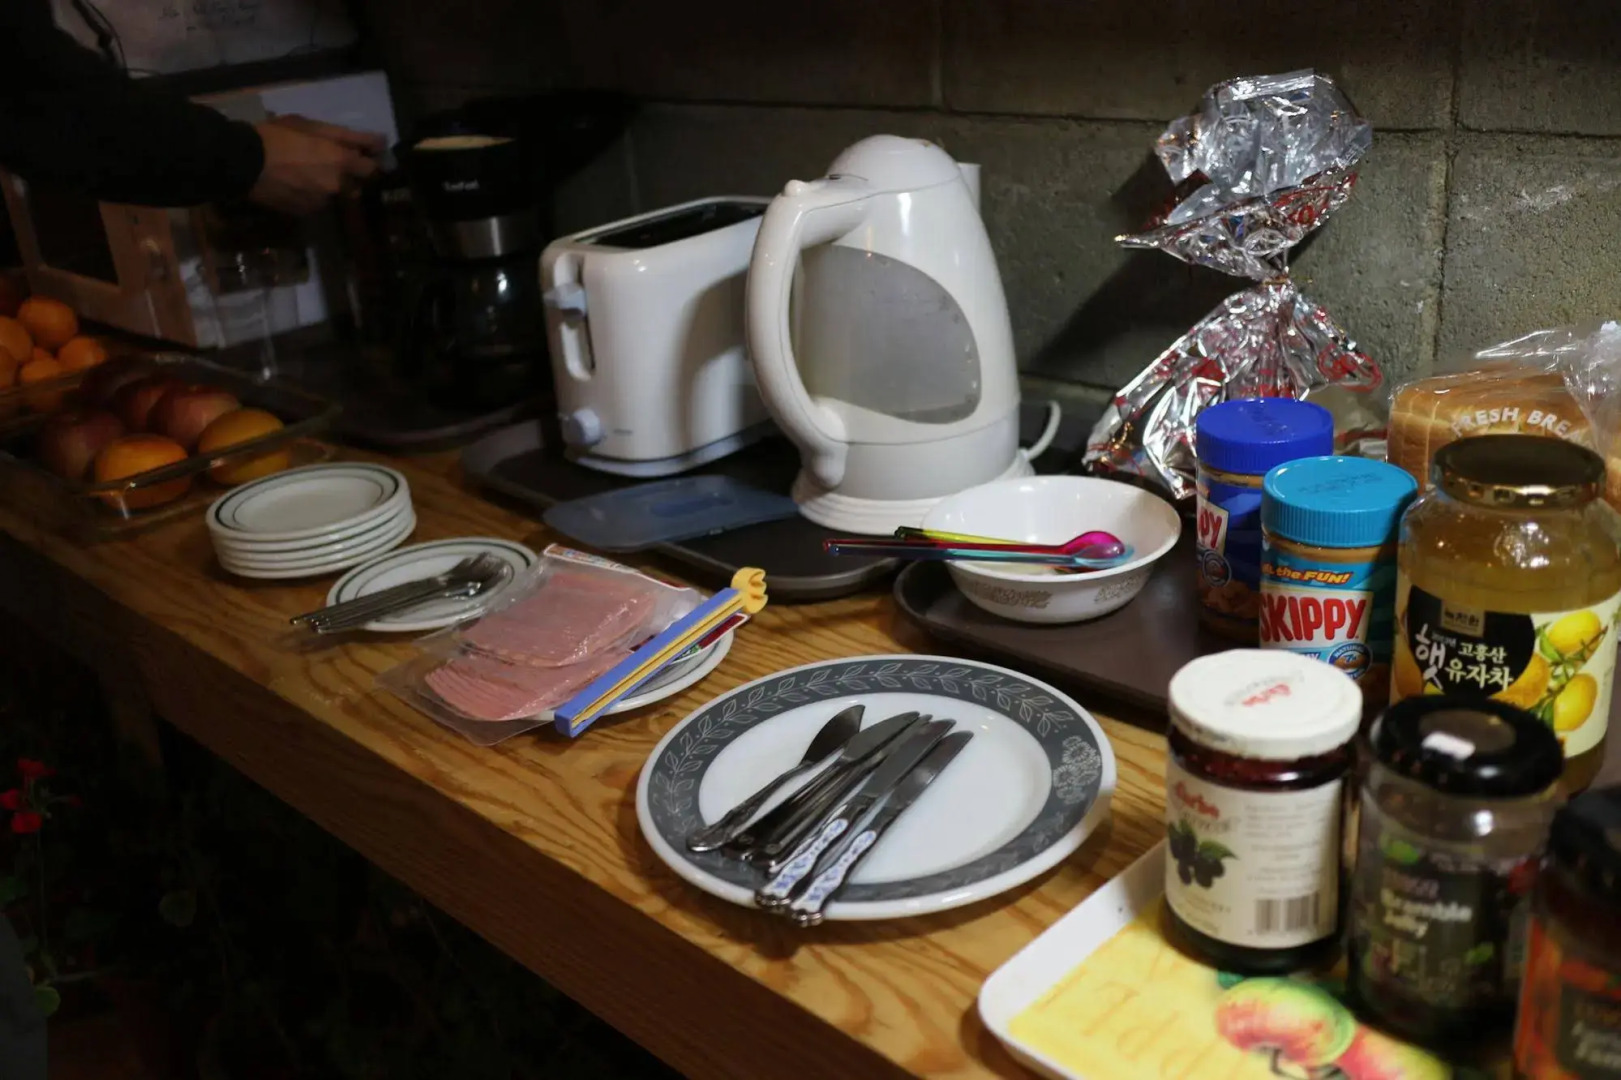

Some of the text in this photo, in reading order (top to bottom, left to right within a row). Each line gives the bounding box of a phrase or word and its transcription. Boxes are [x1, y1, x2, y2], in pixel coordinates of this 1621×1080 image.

[1450, 406, 1584, 443] FRESH BREA
[1275, 565, 1302, 580] the
[1302, 569, 1353, 585] FUN!
[1260, 592, 1367, 643] SKIPPY
[1414, 622, 1446, 691] 햇
[1458, 641, 1507, 664] 고흥산
[1444, 657, 1514, 692] 유자차
